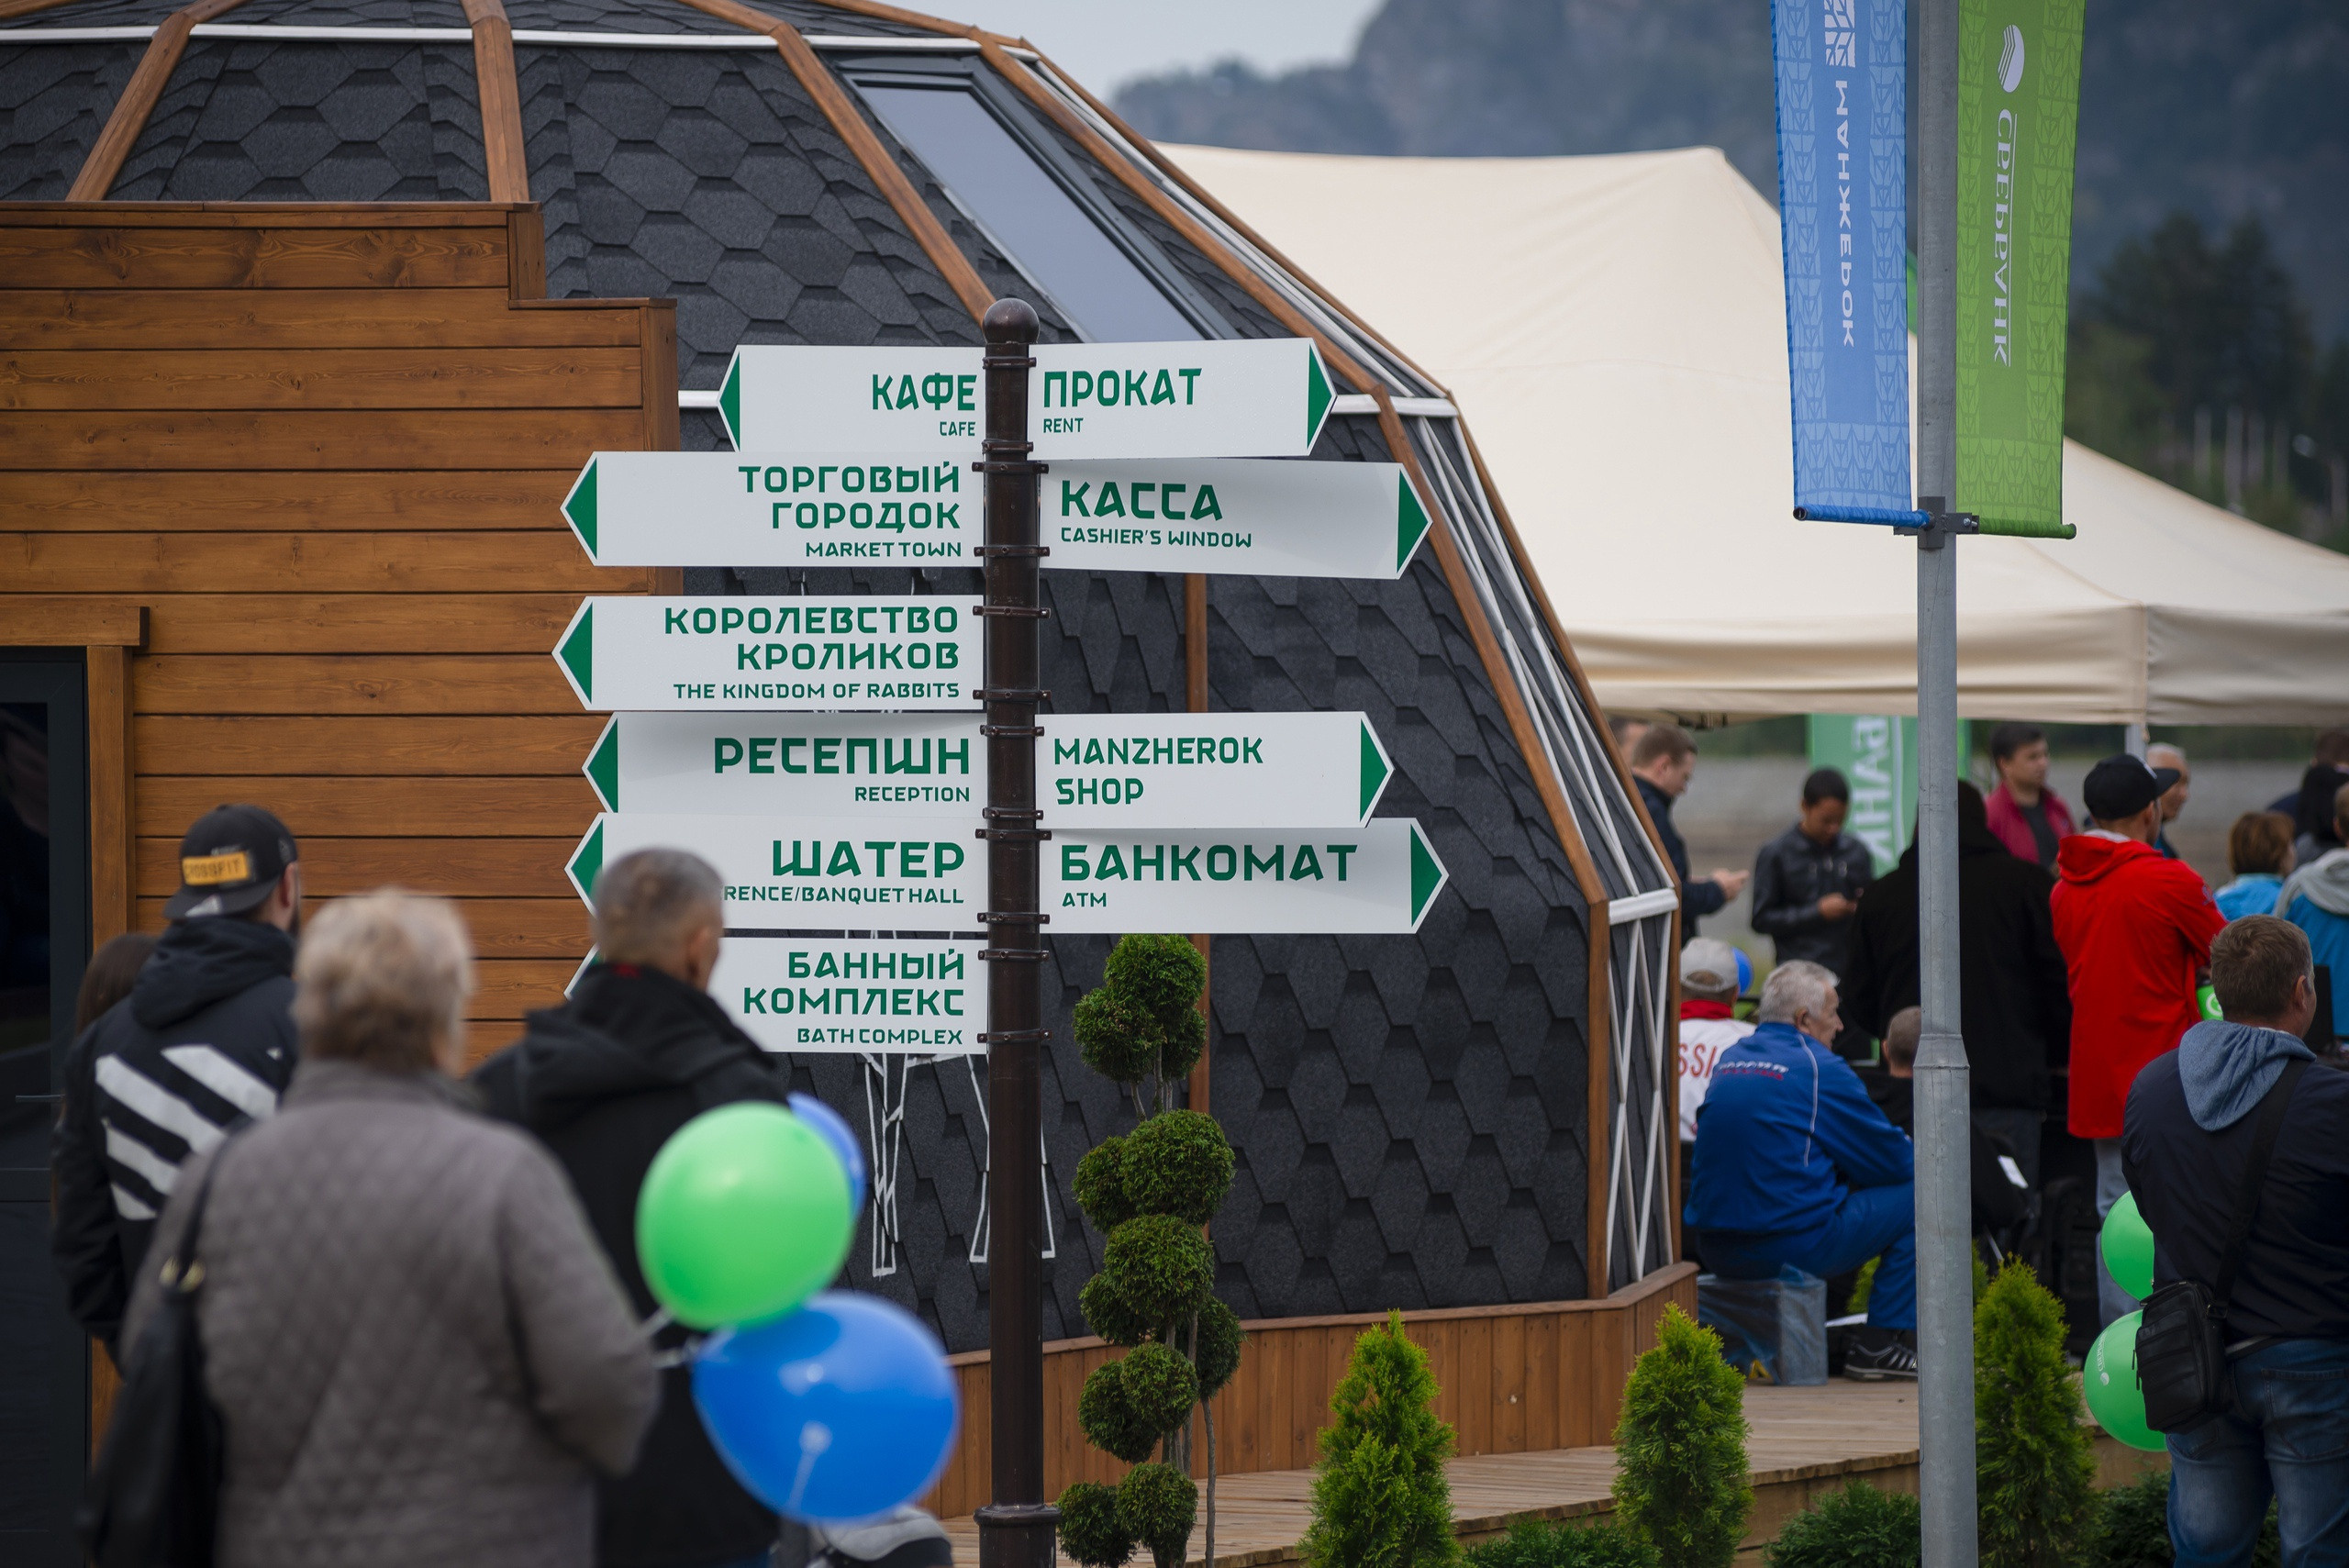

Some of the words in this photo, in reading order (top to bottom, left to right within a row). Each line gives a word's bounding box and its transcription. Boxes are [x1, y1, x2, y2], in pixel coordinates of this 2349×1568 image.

[872, 372, 977, 412] КАФЕ
[1043, 367, 1203, 408] ПРОКАТ
[939, 420, 976, 437] CAFE
[1042, 417, 1085, 434] RENT
[738, 460, 960, 494] ТОРГОВЫЙ
[1061, 479, 1223, 522] КАССА
[772, 501, 961, 534] ГОРОДОК
[805, 541, 896, 558] MARKET
[898, 541, 962, 558] TOWN
[1061, 527, 1163, 546] CASHIER'S
[1167, 530, 1252, 549] WINDOW
[664, 606, 959, 635] КОРОЛЕВСТВО
[737, 641, 960, 671] КРОЛИКОВ
[673, 683, 716, 699] THE
[722, 683, 826, 699] KINGDOM
[832, 683, 862, 699] OF
[866, 682, 960, 698] RABBITS
[714, 737, 970, 775] РЕСЕПШН
[1053, 737, 1264, 765] MANZHEROK
[854, 786, 970, 803] RECEPTION
[1054, 777, 1144, 806] SHOP
[772, 840, 965, 879] ШАТЕР
[1061, 844, 1359, 882] БАНКОМАТ
[723, 885, 907, 906] RENCE/BANQUET
[909, 887, 964, 904] HALL
[1062, 892, 1108, 907] ATM
[788, 948, 964, 981] БАННЫЙ
[743, 986, 964, 1017] КОМПЛЕКС
[797, 1028, 854, 1044] BATH
[859, 1029, 963, 1045] COMPLEX
